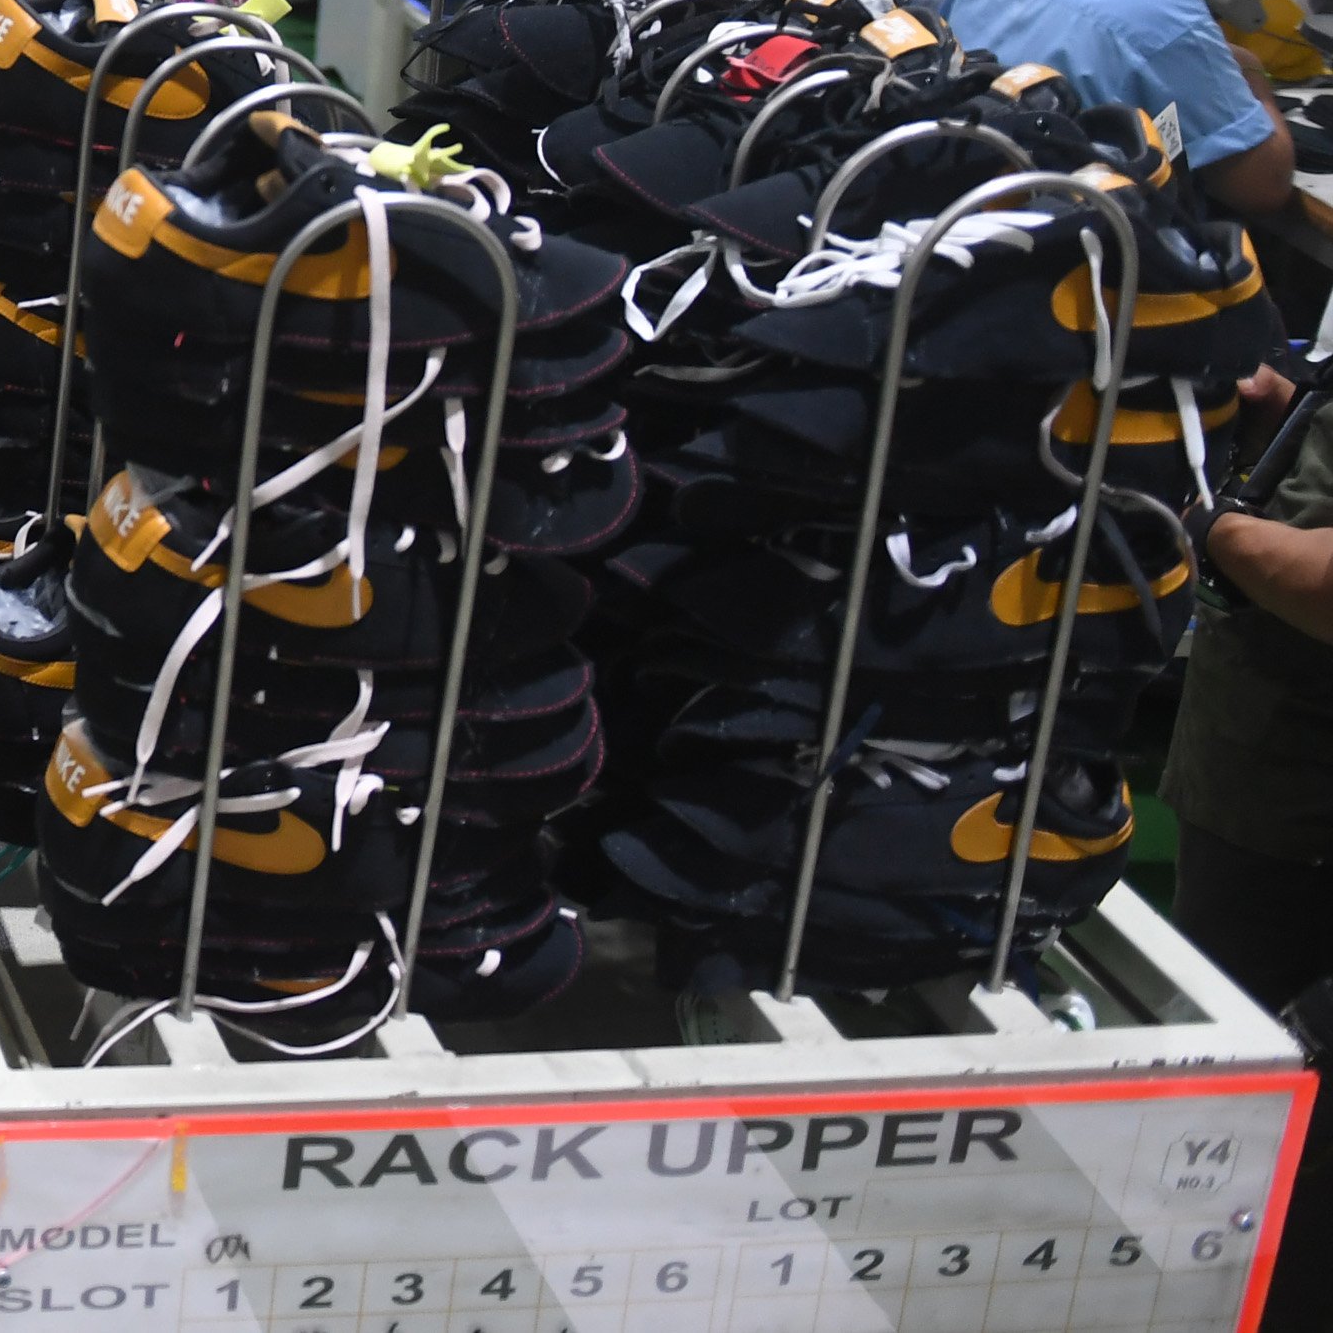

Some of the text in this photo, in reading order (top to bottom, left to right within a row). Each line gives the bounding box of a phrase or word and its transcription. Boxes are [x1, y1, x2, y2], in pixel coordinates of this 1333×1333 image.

[282, 1109, 1023, 1191] RACK UPPER
[1185, 1138, 1232, 1167] Y4
[746, 1194, 853, 1223] LOT
[215, 1279, 242, 1313] 1
[298, 1275, 335, 1311] 2
[390, 1272, 425, 1306] 3
[479, 1268, 517, 1302] 4
[569, 1264, 605, 1298] 5
[655, 1261, 689, 1294] 6
[769, 1252, 796, 1287] 1
[848, 1248, 886, 1282] 2
[937, 1243, 971, 1278] 3
[1021, 1237, 1059, 1272] 4
[1108, 1234, 1143, 1268] 5
[1190, 1229, 1225, 1263] 6
